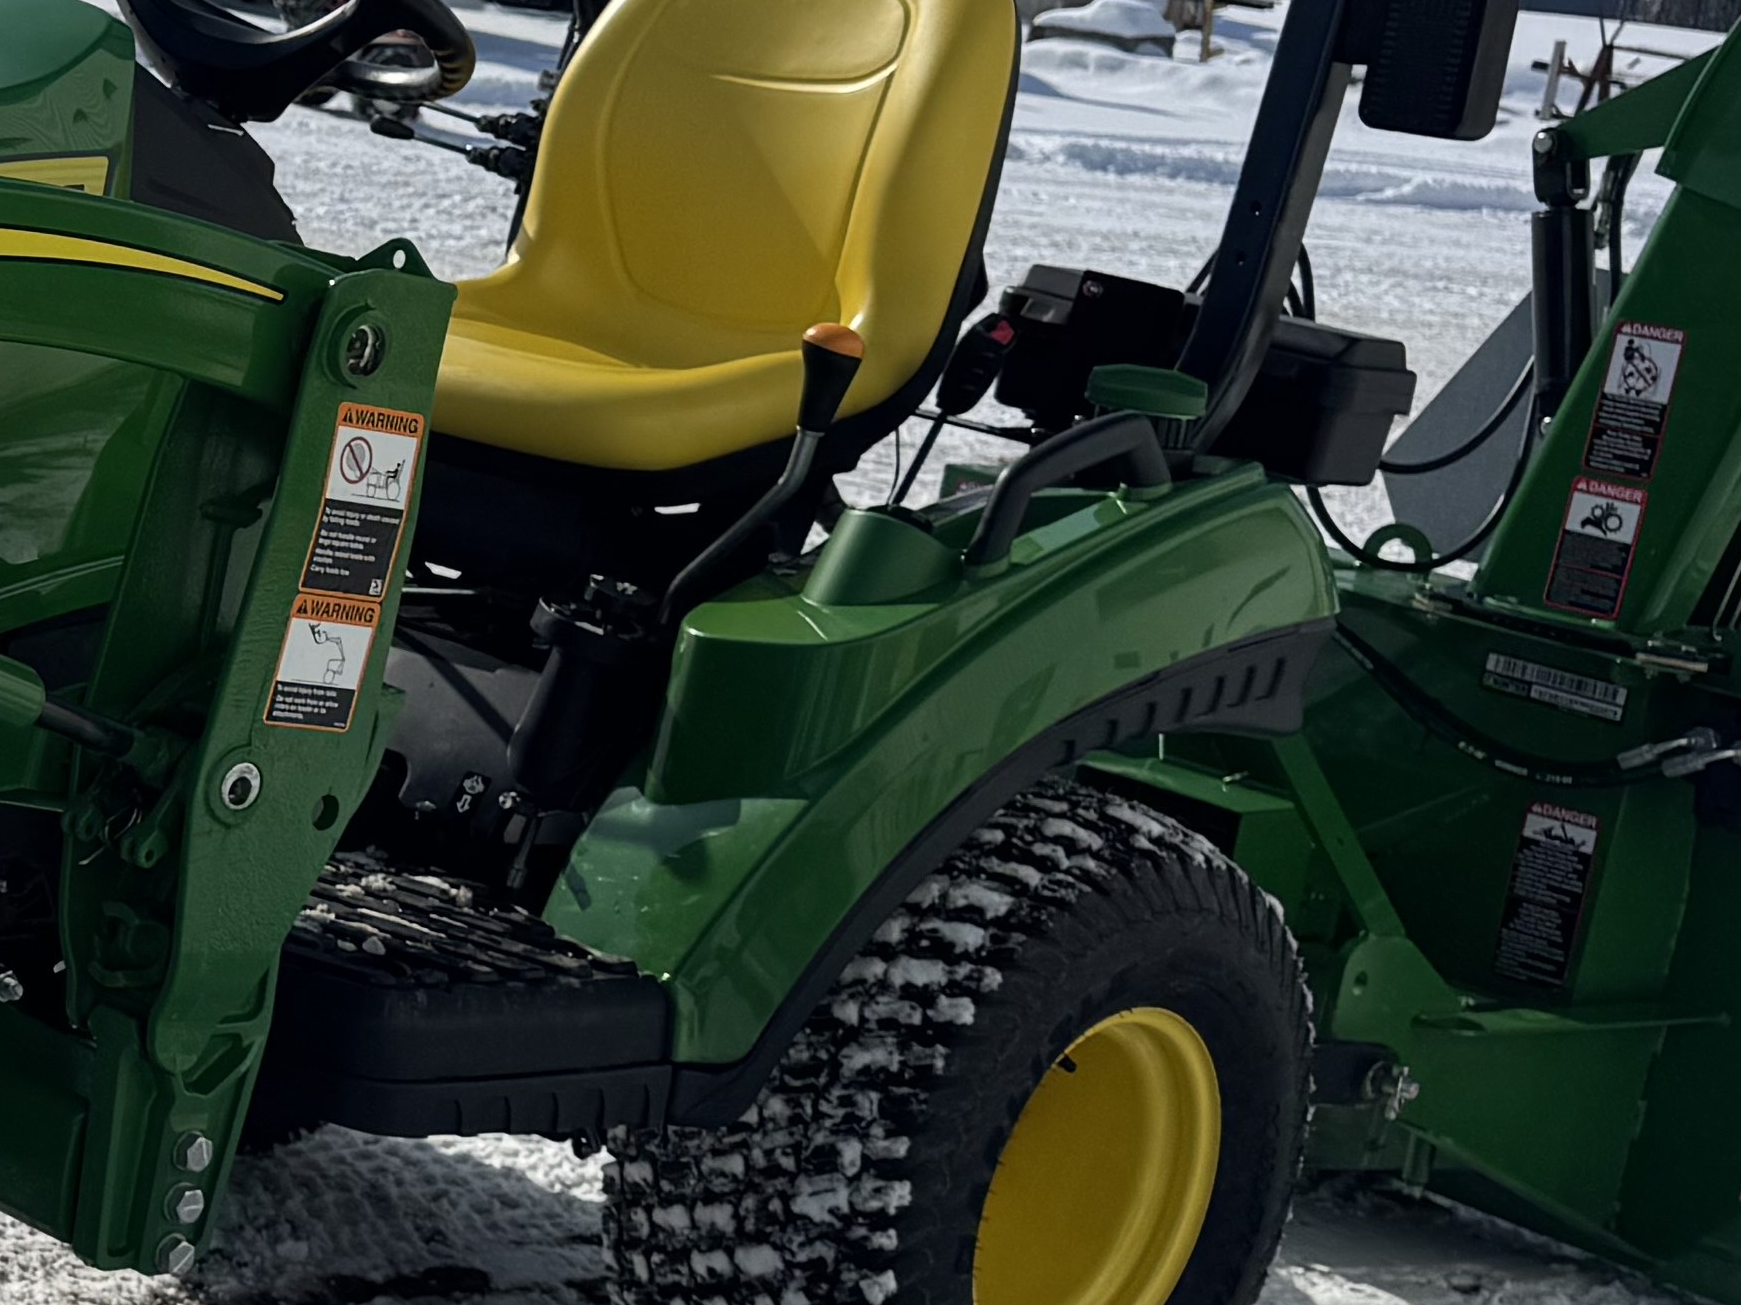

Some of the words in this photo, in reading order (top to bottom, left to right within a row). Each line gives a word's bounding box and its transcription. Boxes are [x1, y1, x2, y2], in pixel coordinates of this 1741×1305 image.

[1630, 322, 1683, 343] DANGER
[353, 407, 420, 435] WARNING
[1587, 478, 1643, 504] DANGER
[307, 598, 376, 624] WARNING
[1541, 803, 1597, 828] DANGER
